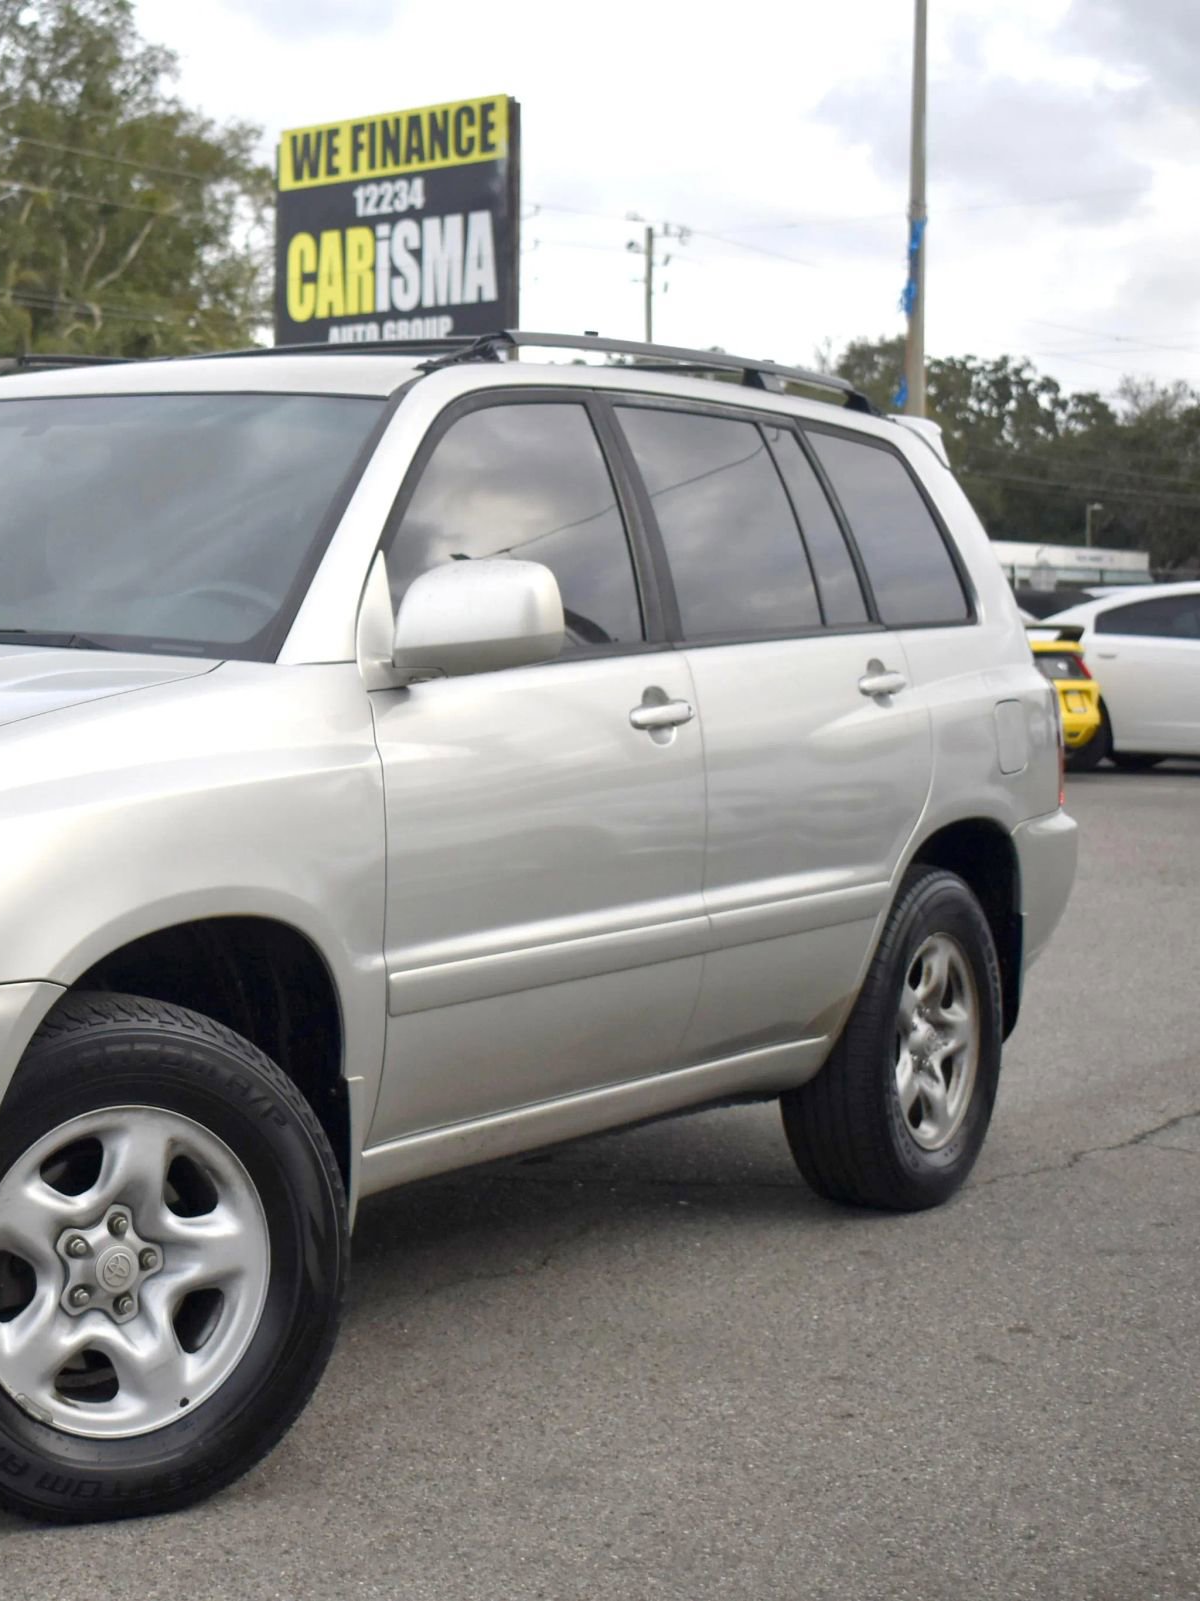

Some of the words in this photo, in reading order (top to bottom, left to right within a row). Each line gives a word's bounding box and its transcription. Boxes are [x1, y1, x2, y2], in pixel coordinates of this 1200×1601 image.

[291, 127, 340, 182] WE
[351, 101, 496, 173] FINANCE
[352, 177, 425, 217] 12234
